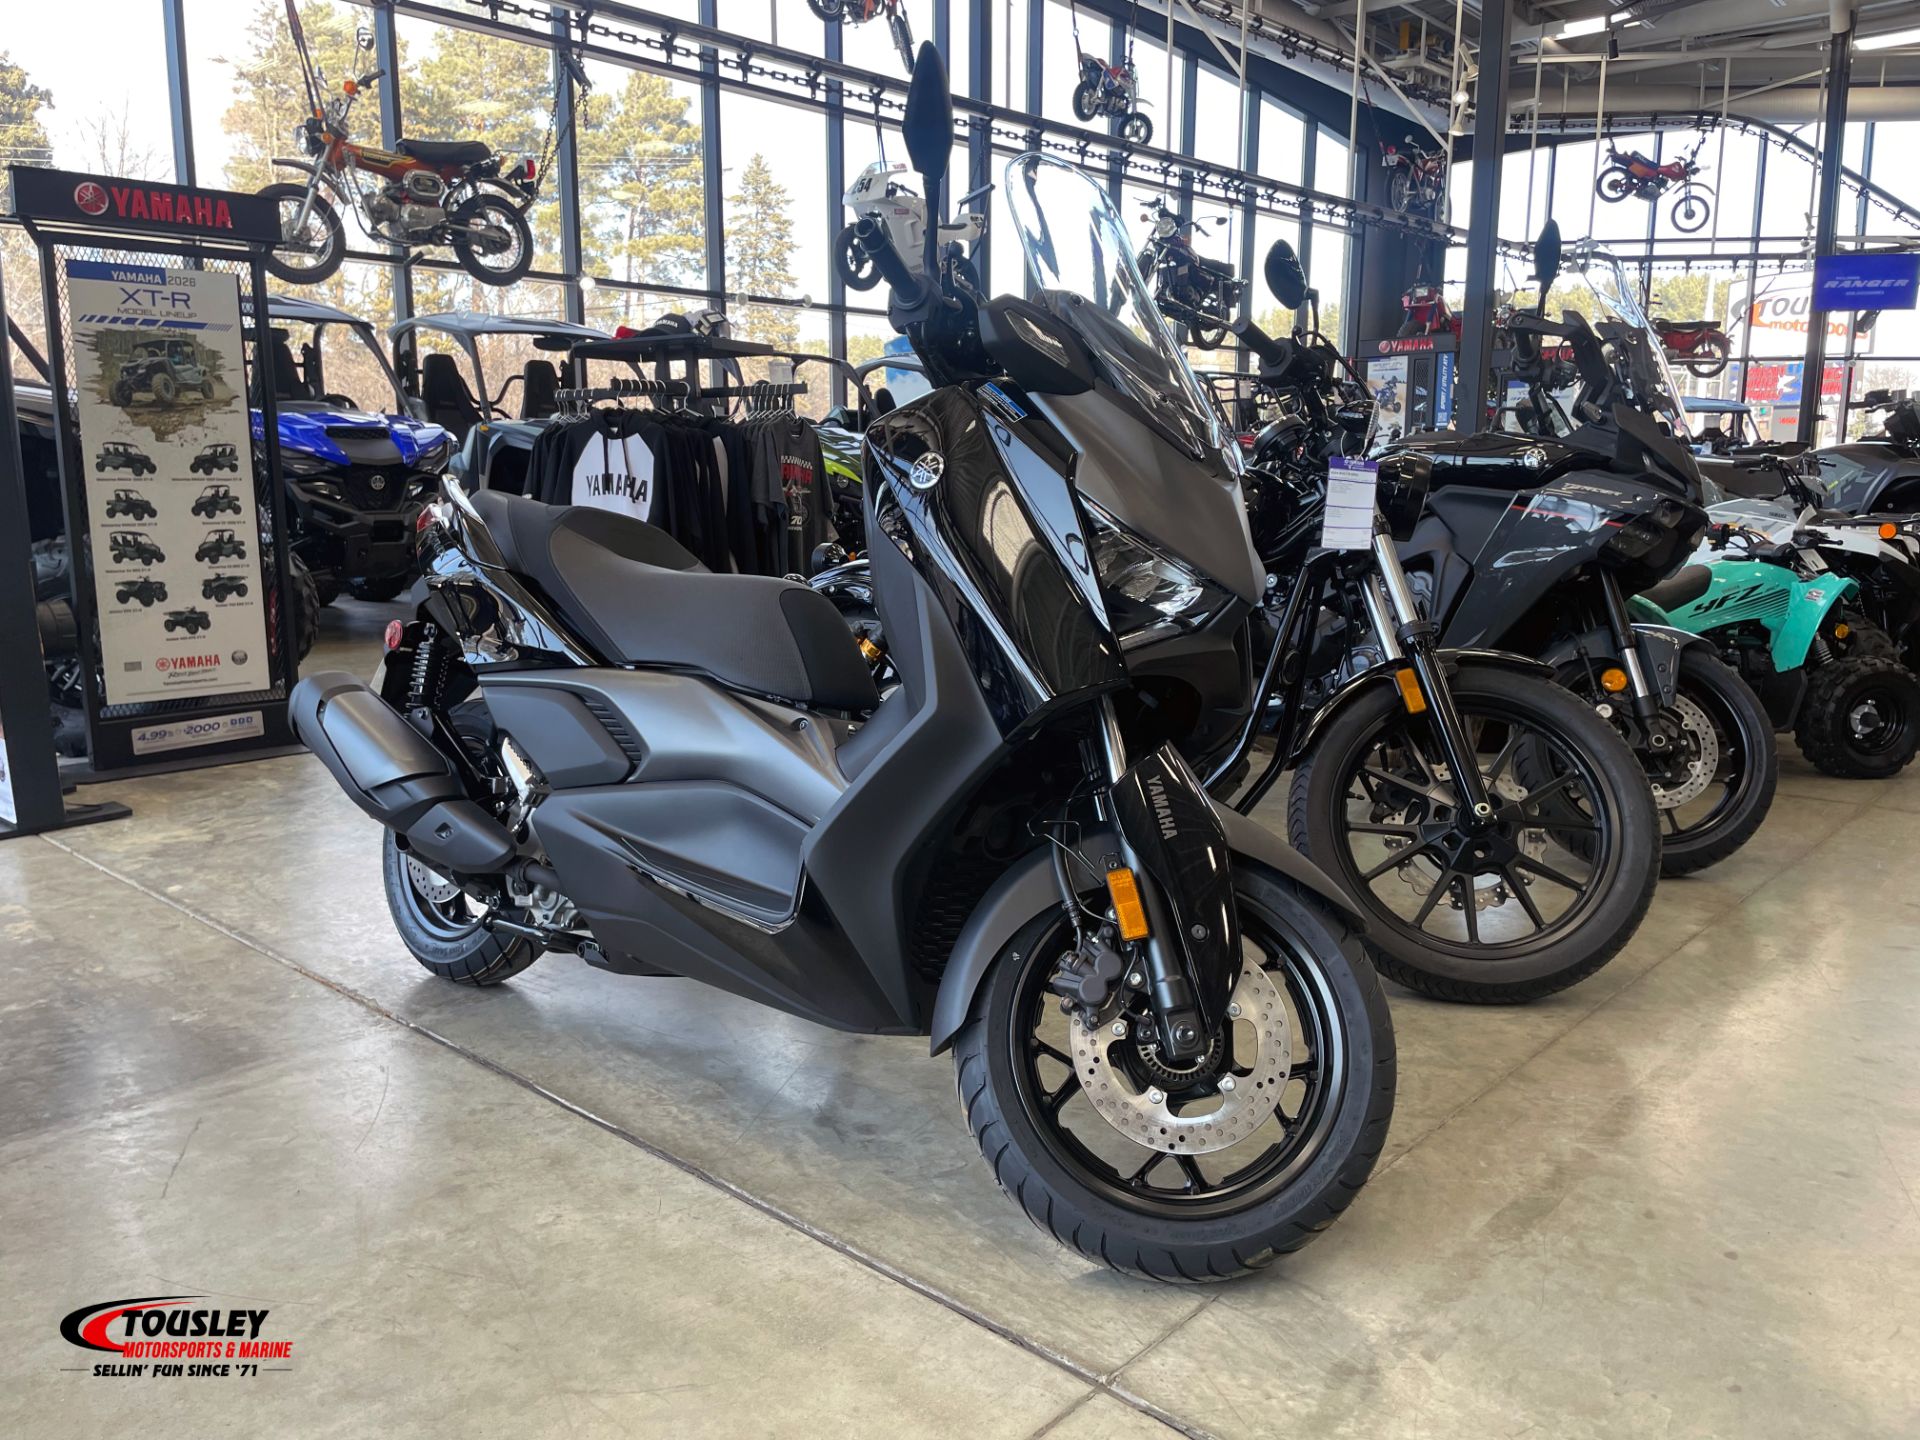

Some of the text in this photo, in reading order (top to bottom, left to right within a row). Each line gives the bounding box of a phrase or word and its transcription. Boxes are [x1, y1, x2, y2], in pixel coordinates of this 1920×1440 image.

[111, 186, 233, 229] YAMAHA
[111, 270, 162, 285] YAMAHA
[1823, 279, 1910, 289] RANGER
[119, 287, 191, 310] XT-R
[117, 307, 198, 319] MODEL LINEUP
[1390, 337, 1434, 353] YAMAHA
[586, 473, 648, 503] YAMAHA
[170, 654, 221, 670] YAMAHA
[1146, 774, 1178, 840] YAMAHA
